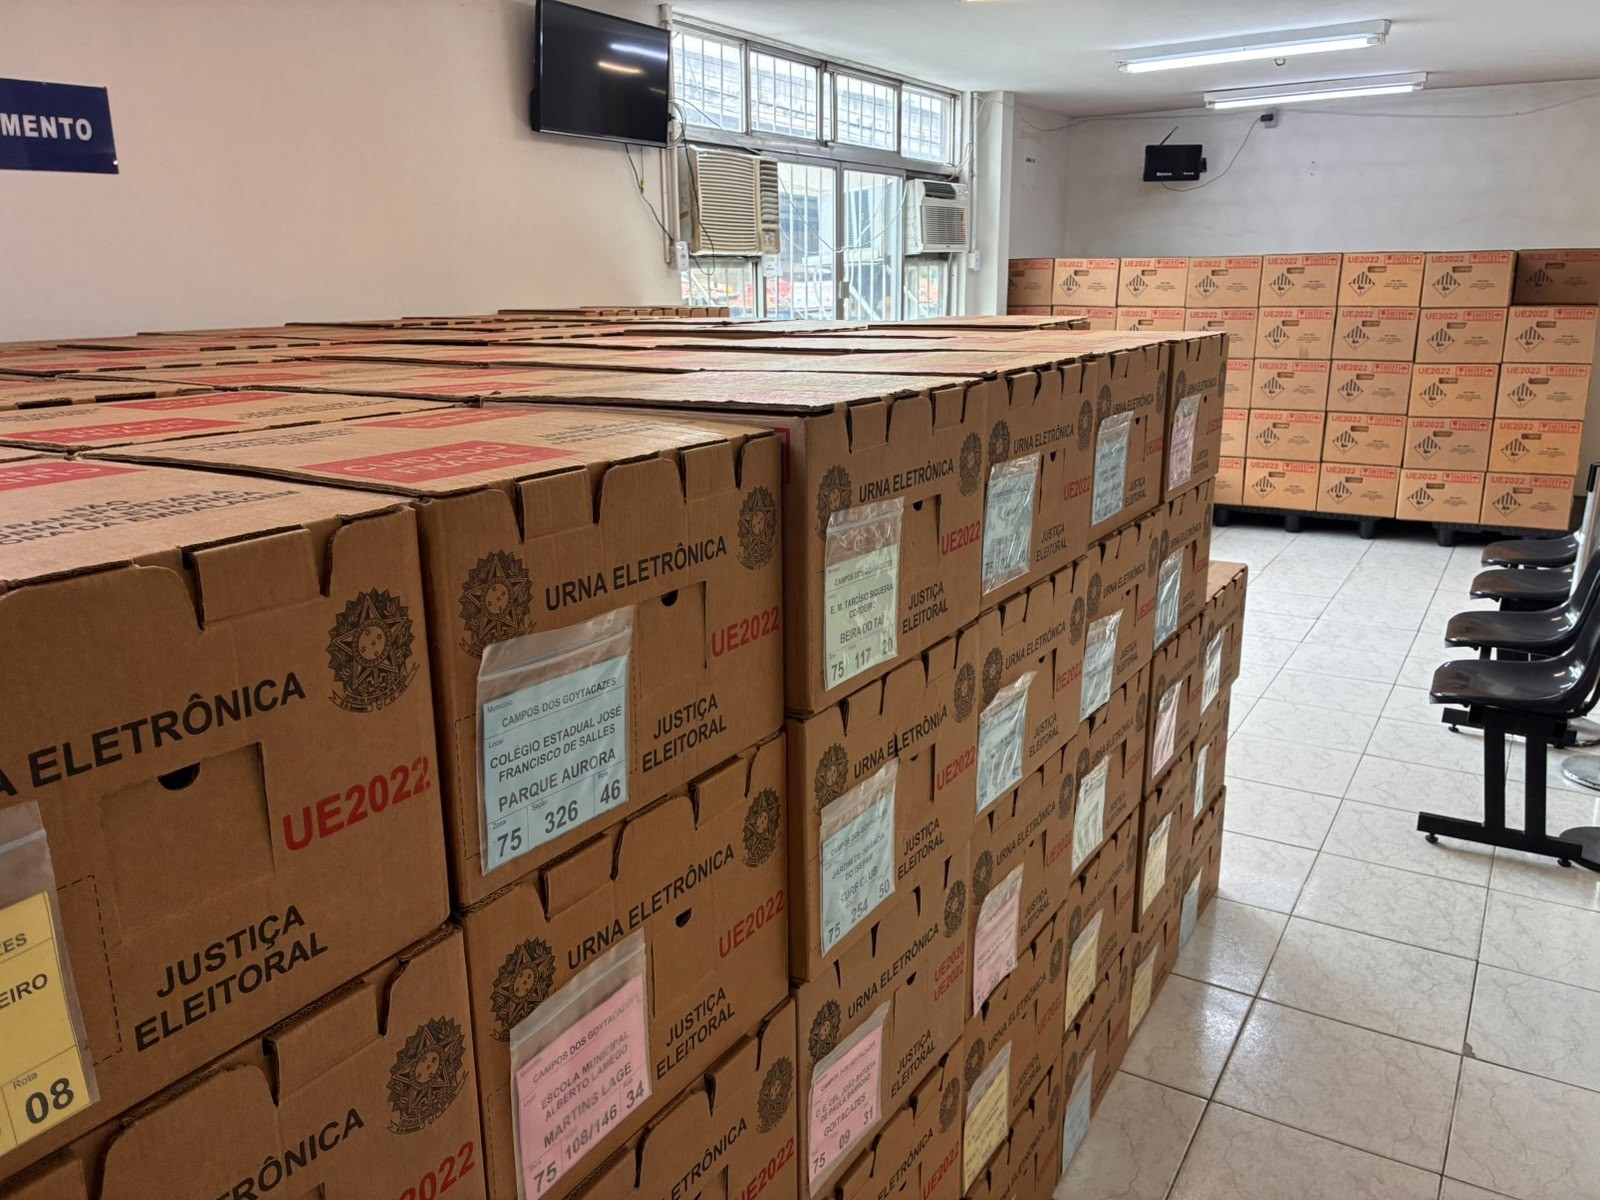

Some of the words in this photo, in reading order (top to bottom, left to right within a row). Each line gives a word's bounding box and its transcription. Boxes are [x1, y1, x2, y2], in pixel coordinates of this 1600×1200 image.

[0, 113, 93, 141] MENTO
[1431, 255, 1464, 263] UE2022
[1425, 312, 1458, 320] UE2022
[1514, 310, 1548, 318] UE2022
[1259, 362, 1288, 370] UE2022
[1418, 367, 1450, 375] UE2022
[1507, 367, 1541, 375] UE2022
[1014, 434, 1034, 454] URNA
[1035, 423, 1074, 447] ELETRÔNICA
[1331, 415, 1362, 424] UE2022
[1413, 420, 1444, 428] UE2022
[344, 444, 506, 472] CUIDADO
[1250, 461, 1279, 469] UE2022
[1325, 466, 1356, 475] UE2022
[1406, 472, 1437, 480] UE2022
[859, 478, 890, 503] URNA
[893, 459, 954, 492] ELETRÔNICA
[1064, 475, 1091, 501] UE2022
[1491, 477, 1525, 485] UE2022
[0, 494, 209, 531] RANSPORTAR
[76, 522, 126, 532] DA
[126, 490, 302, 522] EMBALAGEM
[1041, 522, 1065, 544] JUSTIÇA
[942, 521, 981, 556] UE2022
[1036, 540, 1067, 562] ELEITORAL
[545, 573, 608, 611] URNA
[613, 535, 727, 590] ELETRÔNICA
[909, 581, 944, 610] JUSTIÇA
[711, 606, 780, 658] UE2022
[840, 626, 861, 644] BEIRA
[863, 620, 873, 634] DO
[902, 598, 949, 635] ELEITORAL
[831, 661, 844, 681] 75
[855, 647, 871, 669] 117
[882, 637, 893, 655] 20
[502, 705, 540, 728] CAMPOS
[542, 698, 561, 713] DOS
[562, 677, 617, 704] GOYTACAZES
[653, 693, 718, 740] JUSTIÇA
[28, 672, 306, 789] ELETRÔNICA
[490, 740, 540, 769] COLÉGIO
[543, 718, 595, 748] ESTADUAL
[597, 704, 622, 724] JOSÉ
[499, 747, 561, 783] FRANCISCO
[563, 740, 577, 754] DE
[579, 723, 616, 748] SALLES
[641, 714, 727, 773] ELEITORAL
[498, 773, 558, 813] PARQUE
[561, 747, 616, 784] AURORA
[854, 747, 885, 780] URNA
[936, 745, 976, 791] UE2022
[283, 756, 431, 851] UE2022
[496, 826, 522, 858] 75
[544, 800, 579, 834] 326
[600, 779, 621, 804] 46
[898, 832, 945, 880] ELEITORAL
[904, 817, 940, 856] JUSTIÇA
[860, 866, 877, 887] CUB
[567, 918, 624, 969] URNA
[628, 843, 734, 931] ELETRÔNICA
[717, 889, 785, 959] UE2022
[828, 922, 840, 944] 75
[851, 897, 868, 923] 254
[879, 878, 889, 898] 50
[157, 905, 305, 998] JUSTIÇA
[848, 984, 878, 1019] URNA
[880, 923, 939, 988] ELETRÔNICA
[134, 932, 329, 1052] ELEITORAL
[665, 986, 727, 1048] JUSTIÇA
[533, 1051, 568, 1084] CAMPOS
[570, 1037, 586, 1055] DOS
[587, 997, 637, 1040] GOYTAC
[656, 1001, 735, 1080] ELEITORAL
[897, 1029, 931, 1074] JUSTIÇA
[12, 1072, 38, 1091] Rota
[541, 1072, 580, 1110] ESCOLA
[582, 1031, 629, 1075] MUNICIPAL
[545, 1078, 590, 1122] ALBERTO
[591, 1044, 628, 1081] LAMEGO
[891, 1043, 935, 1098] ELEITORAL
[25, 1077, 74, 1124] 08
[544, 1093, 599, 1148] MARTINS
[601, 1061, 632, 1097] LAGE
[824, 1092, 866, 1137] GOITACAZES
[533, 1161, 557, 1193] 75
[565, 1104, 617, 1160] 108/146
[626, 1080, 644, 1109] 34
[661, 1117, 747, 1200] ETRÔNICA
[813, 1151, 826, 1174] 75
[840, 1129, 850, 1150] 09
[864, 1105, 873, 1126] 31
